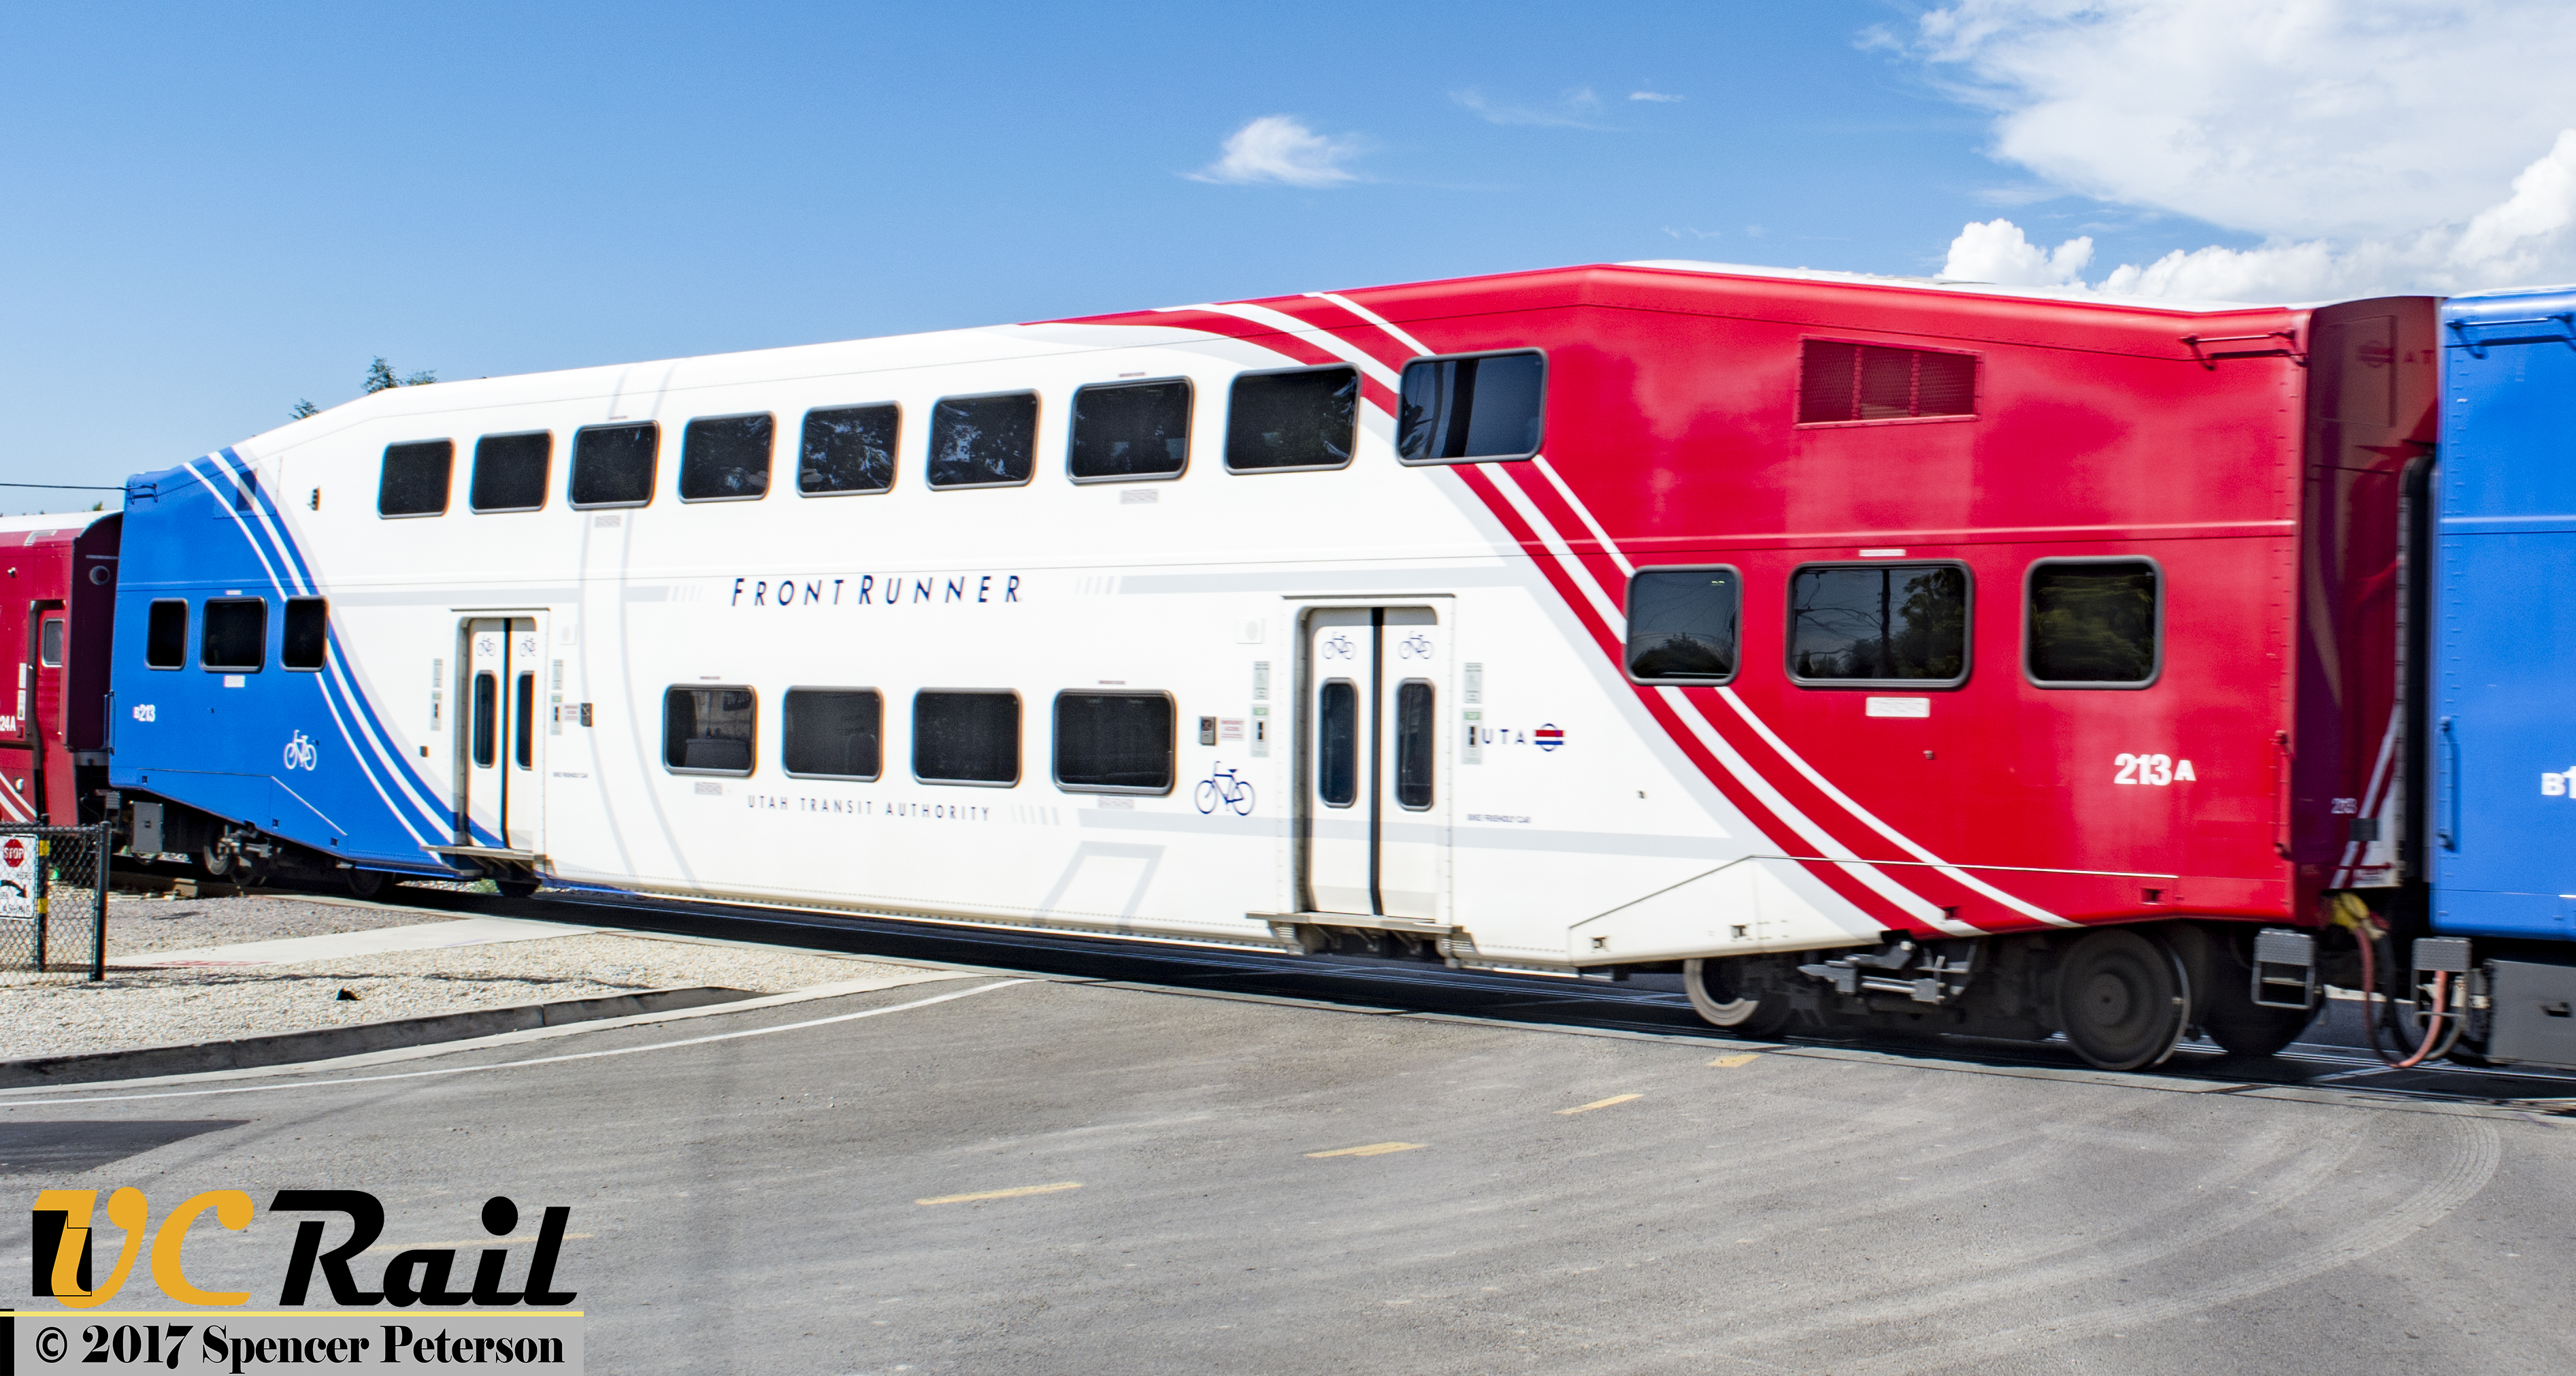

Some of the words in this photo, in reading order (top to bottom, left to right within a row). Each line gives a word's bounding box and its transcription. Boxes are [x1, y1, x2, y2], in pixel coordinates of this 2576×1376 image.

[1481, 728, 1527, 744] UTA
[748, 795, 788, 810] UTAH
[799, 798, 873, 815] TRANSIT
[885, 802, 990, 821] AUTHORITY
[3, 847, 24, 859] STOP
